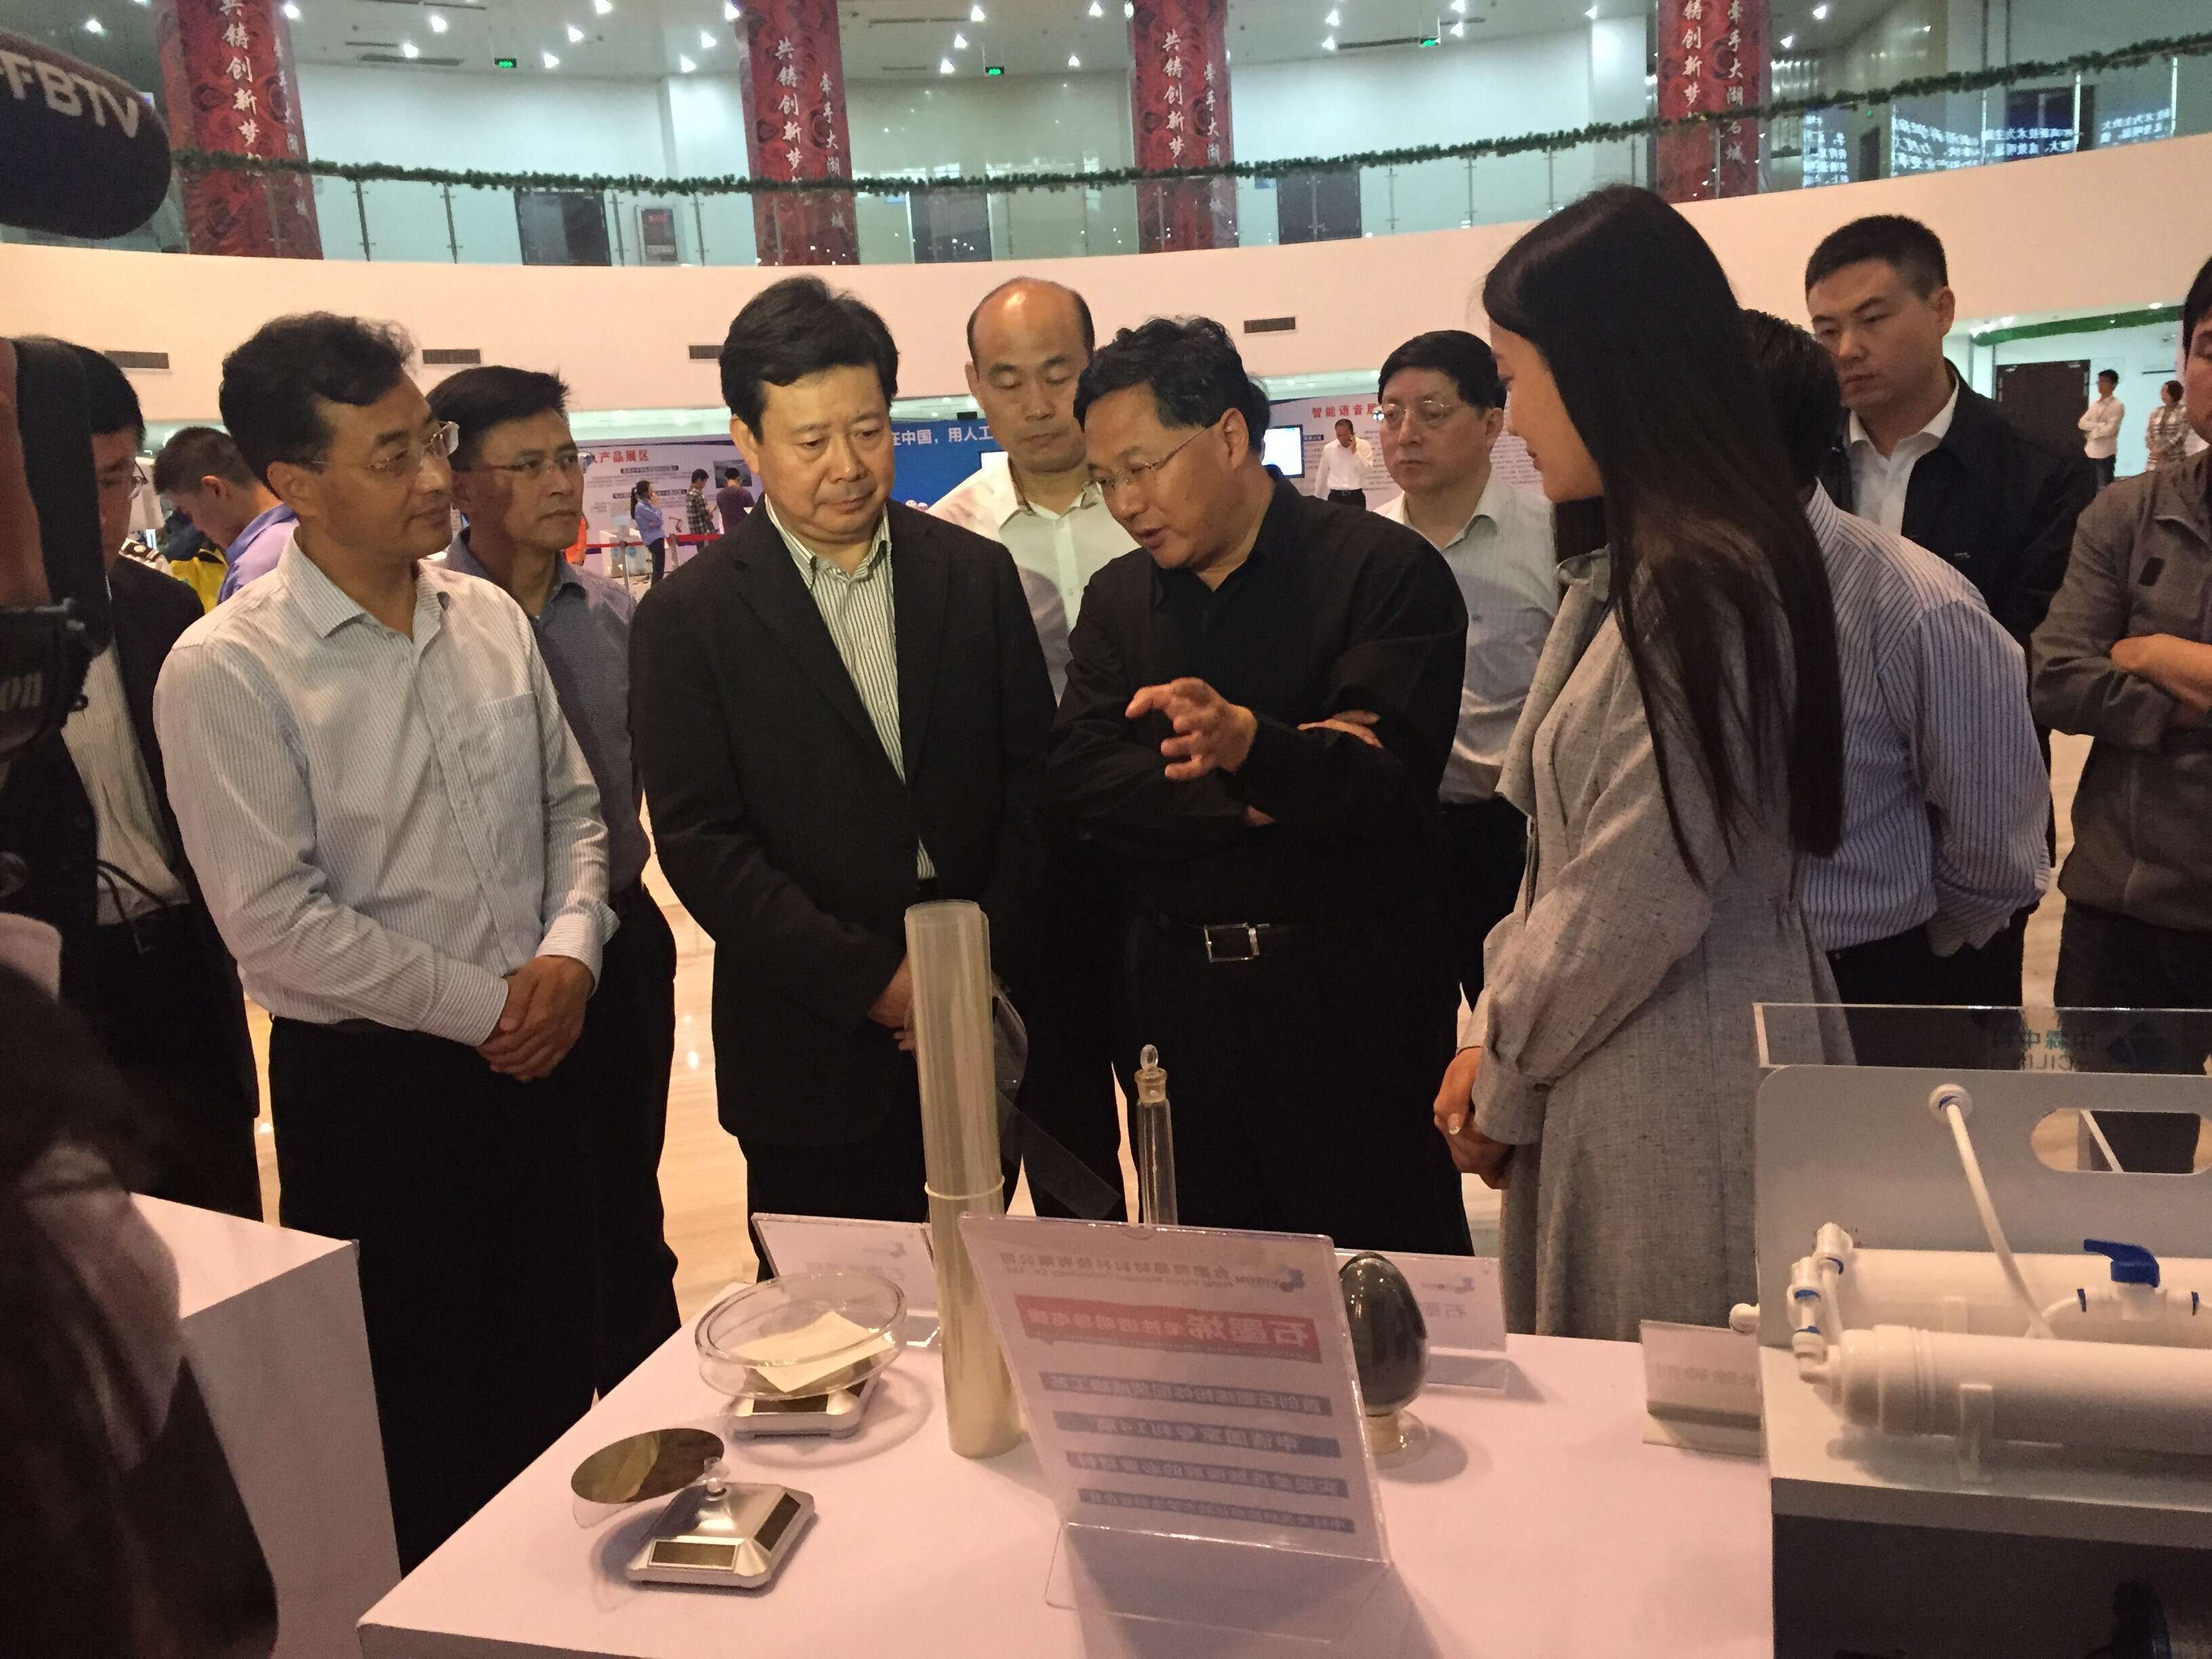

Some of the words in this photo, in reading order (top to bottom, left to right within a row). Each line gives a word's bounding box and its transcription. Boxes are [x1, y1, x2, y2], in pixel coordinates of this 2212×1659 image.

[0, 49, 138, 138] FBTV
[1162, 28, 1185, 168] 共铸创新梦
[1681, 0, 1703, 119] 铸创新梦
